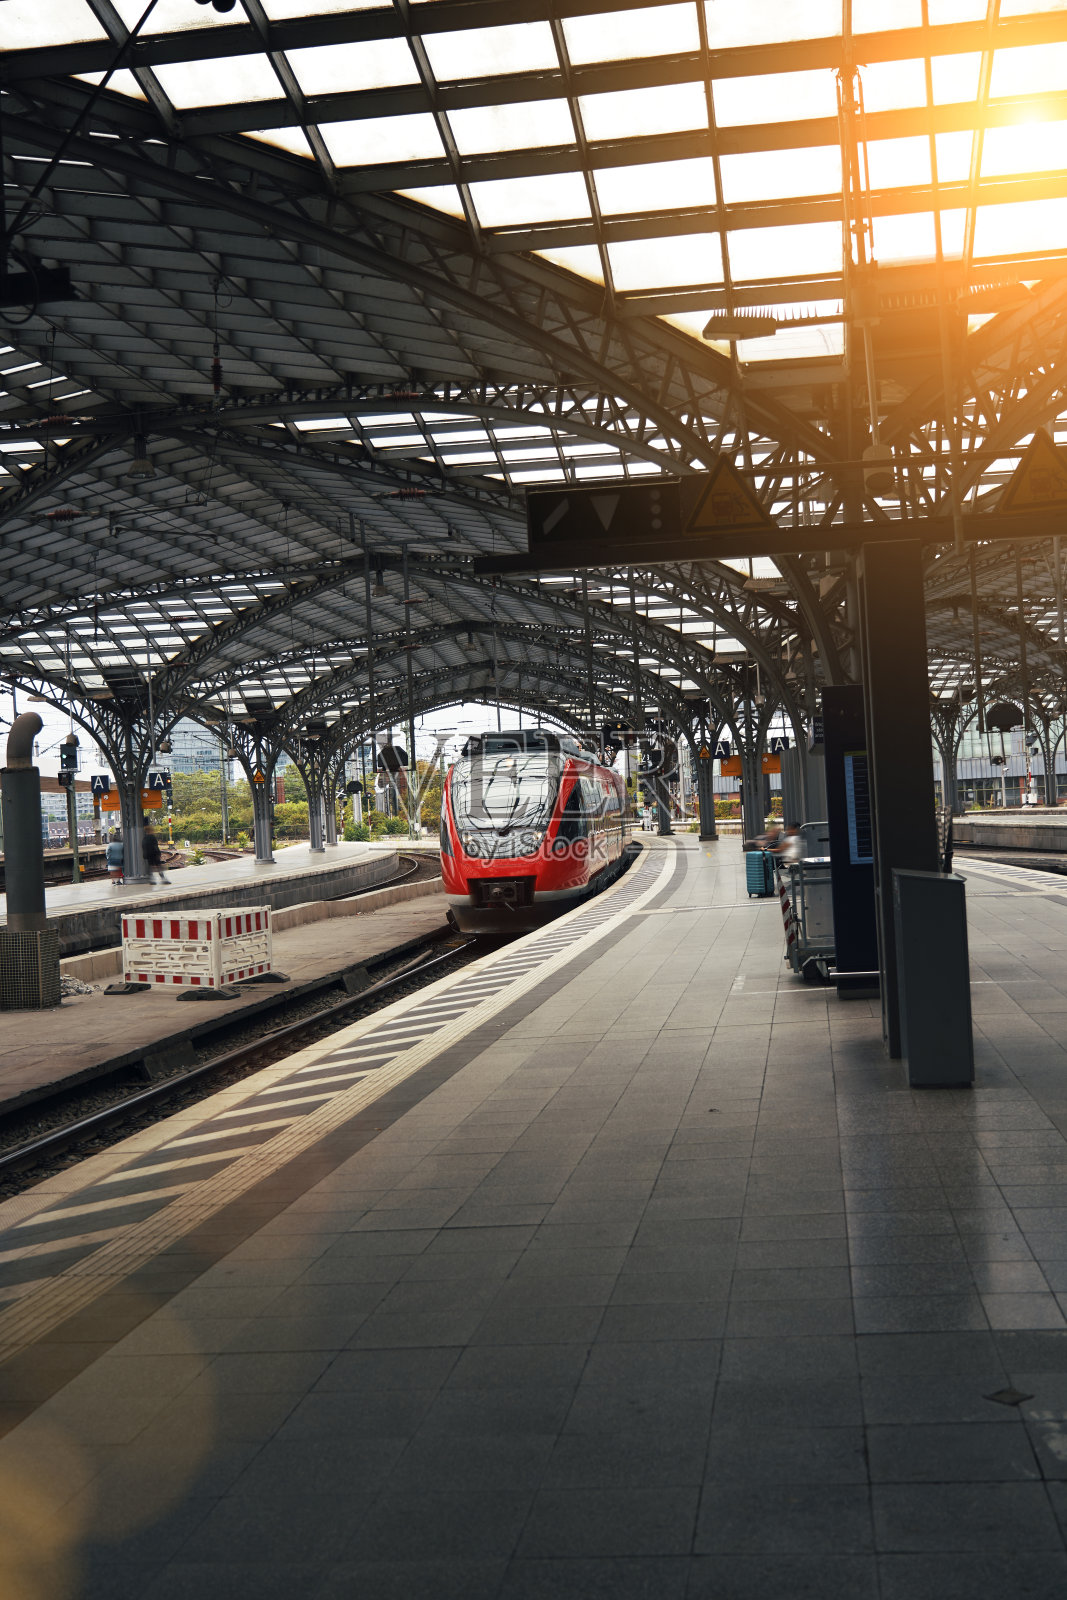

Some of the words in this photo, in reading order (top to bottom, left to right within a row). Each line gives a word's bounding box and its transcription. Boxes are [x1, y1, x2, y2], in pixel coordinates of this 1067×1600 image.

[715, 742, 726, 756] A
[774, 738, 785, 751] A
[94, 776, 104, 790] A
[153, 773, 164, 787] A
